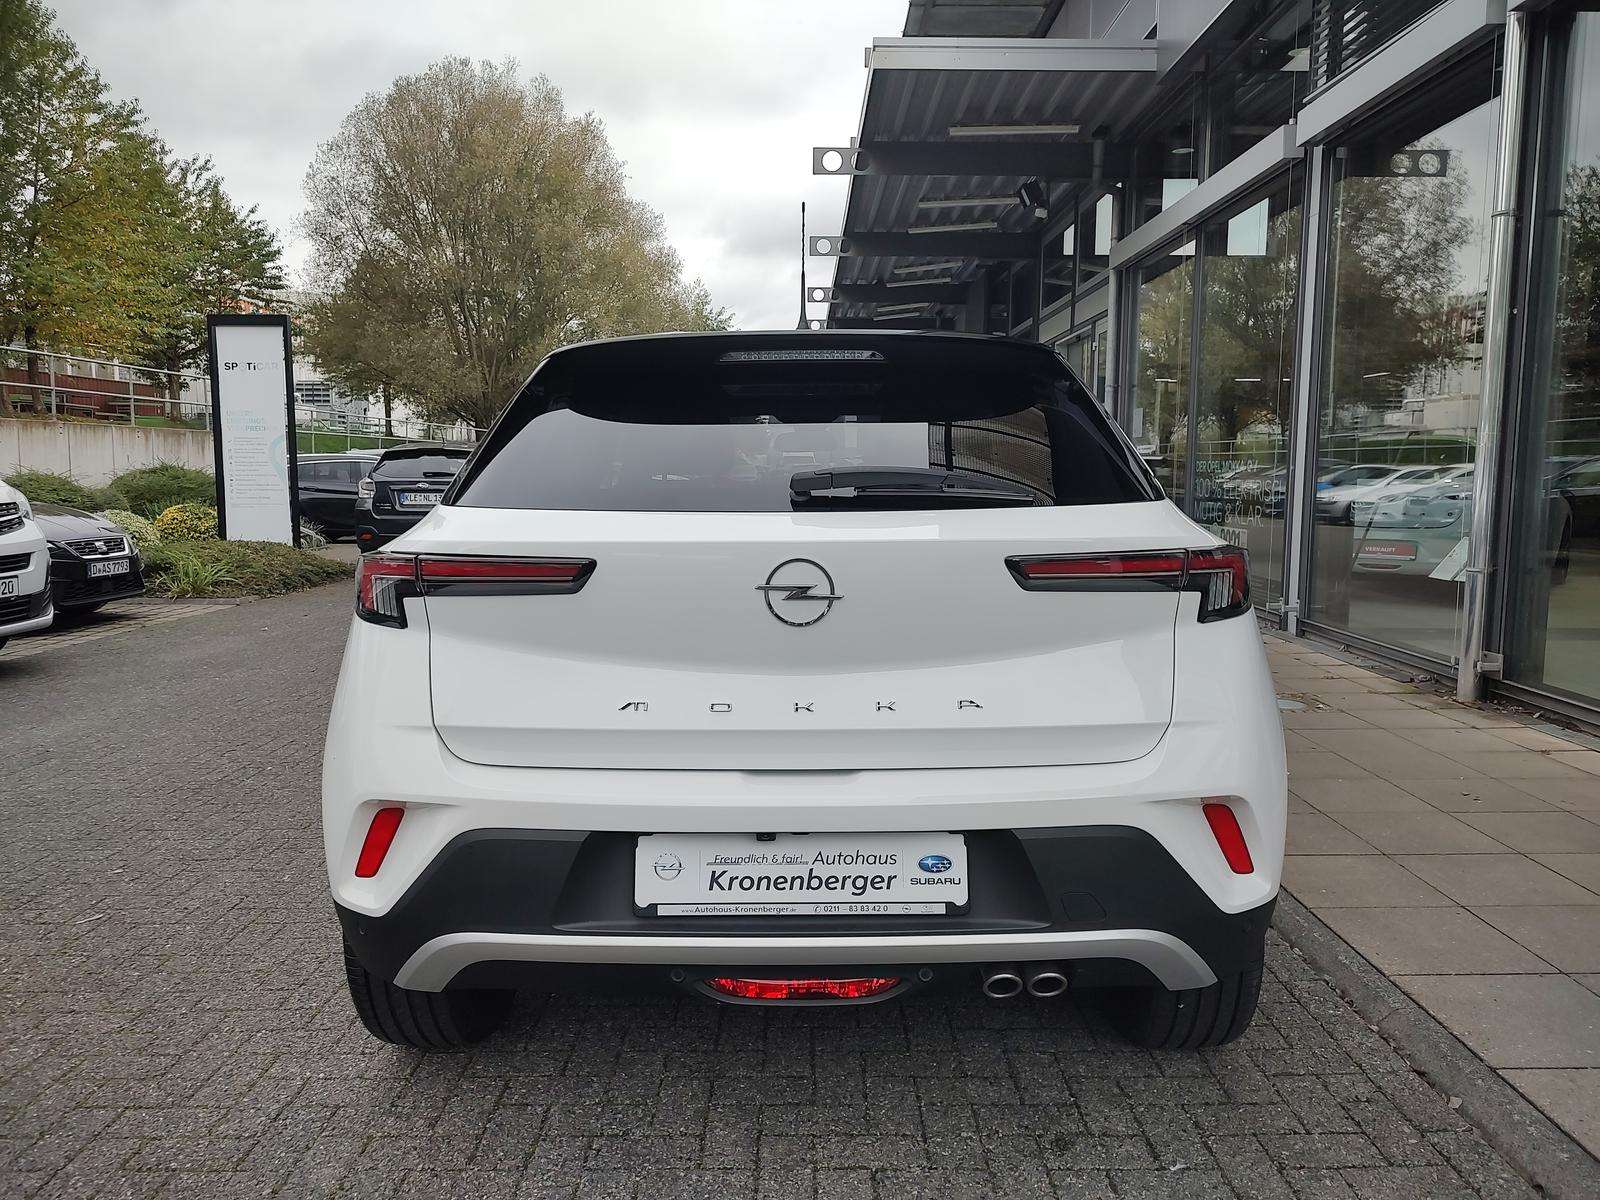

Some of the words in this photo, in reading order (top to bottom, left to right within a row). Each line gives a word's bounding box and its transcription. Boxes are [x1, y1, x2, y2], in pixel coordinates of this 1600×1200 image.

[618, 700, 984, 712] MOKKA
[714, 853, 768, 864] Freundlich
[771, 854, 779, 864] &
[811, 850, 897, 866] Autohaus
[708, 867, 898, 897] Kronenberger
[910, 877, 962, 886] SUBARU
[823, 904, 840, 912] 0211
[848, 904, 858, 912] 83
[860, 904, 870, 912] 83
